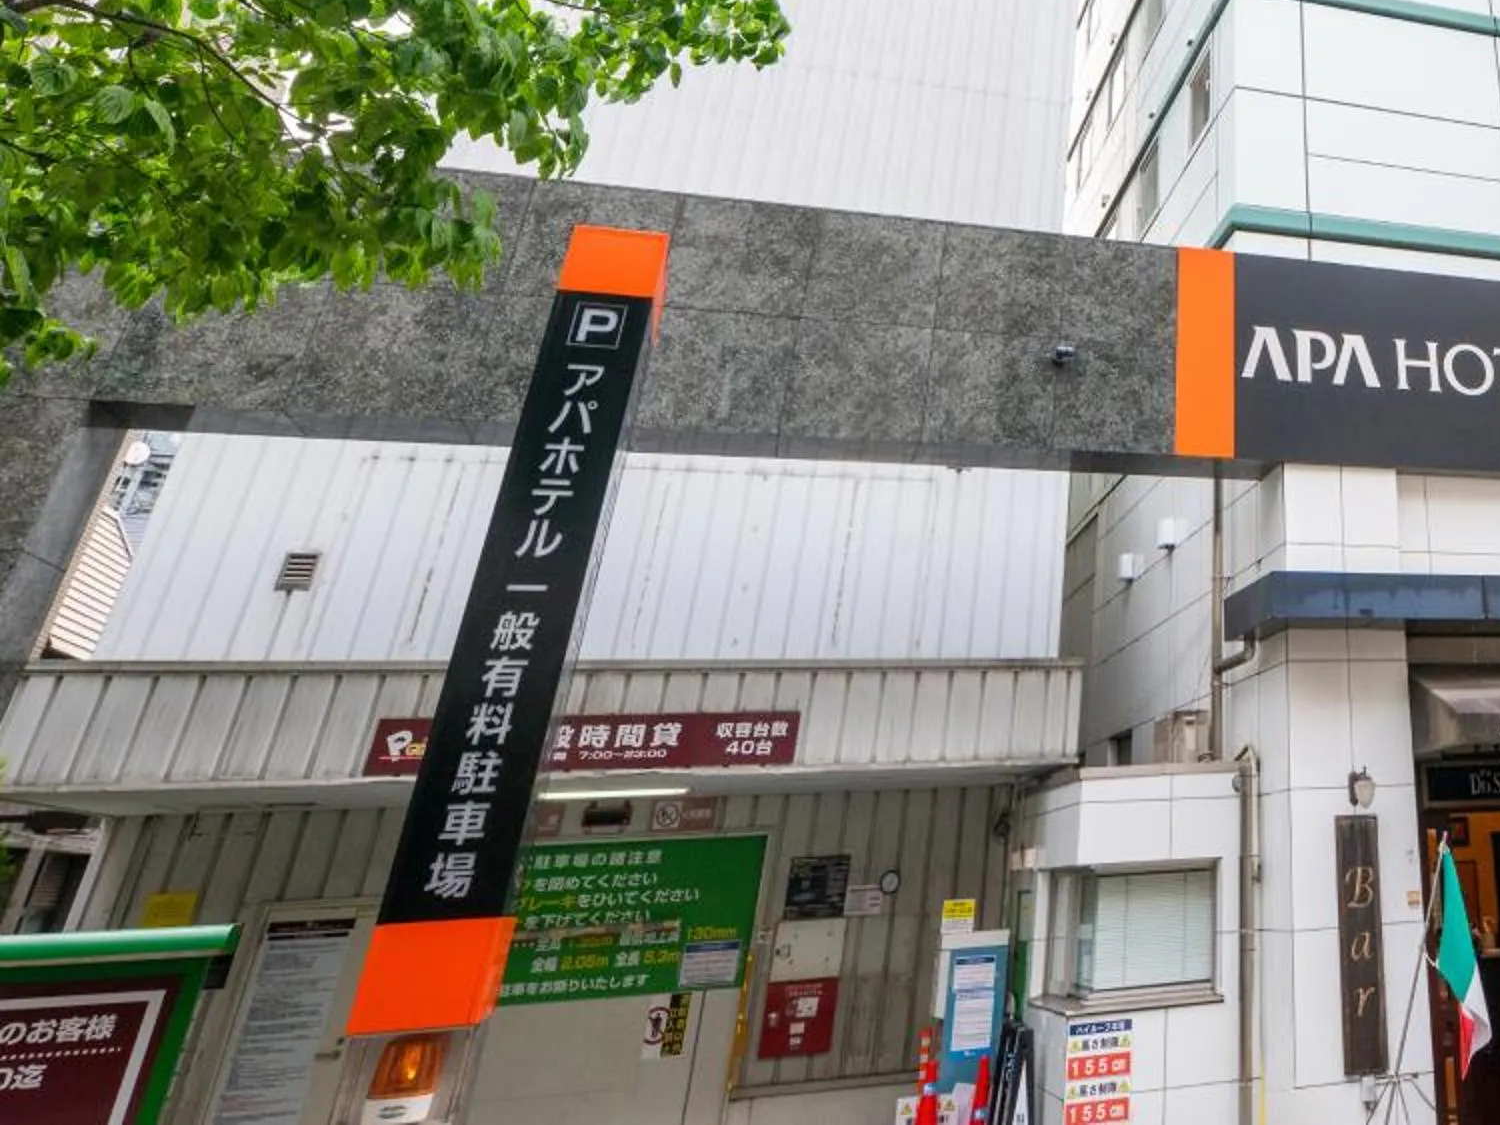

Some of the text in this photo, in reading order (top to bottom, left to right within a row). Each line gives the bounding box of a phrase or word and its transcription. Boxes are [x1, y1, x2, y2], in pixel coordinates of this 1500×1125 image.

[1241, 325, 1382, 388] APA
[427, 361, 607, 900] アパホテル 一般有料駐車場
[725, 739, 773, 756] 40台
[1344, 865, 1376, 1018] Bar
[0, 1013, 118, 1047] のお客様
